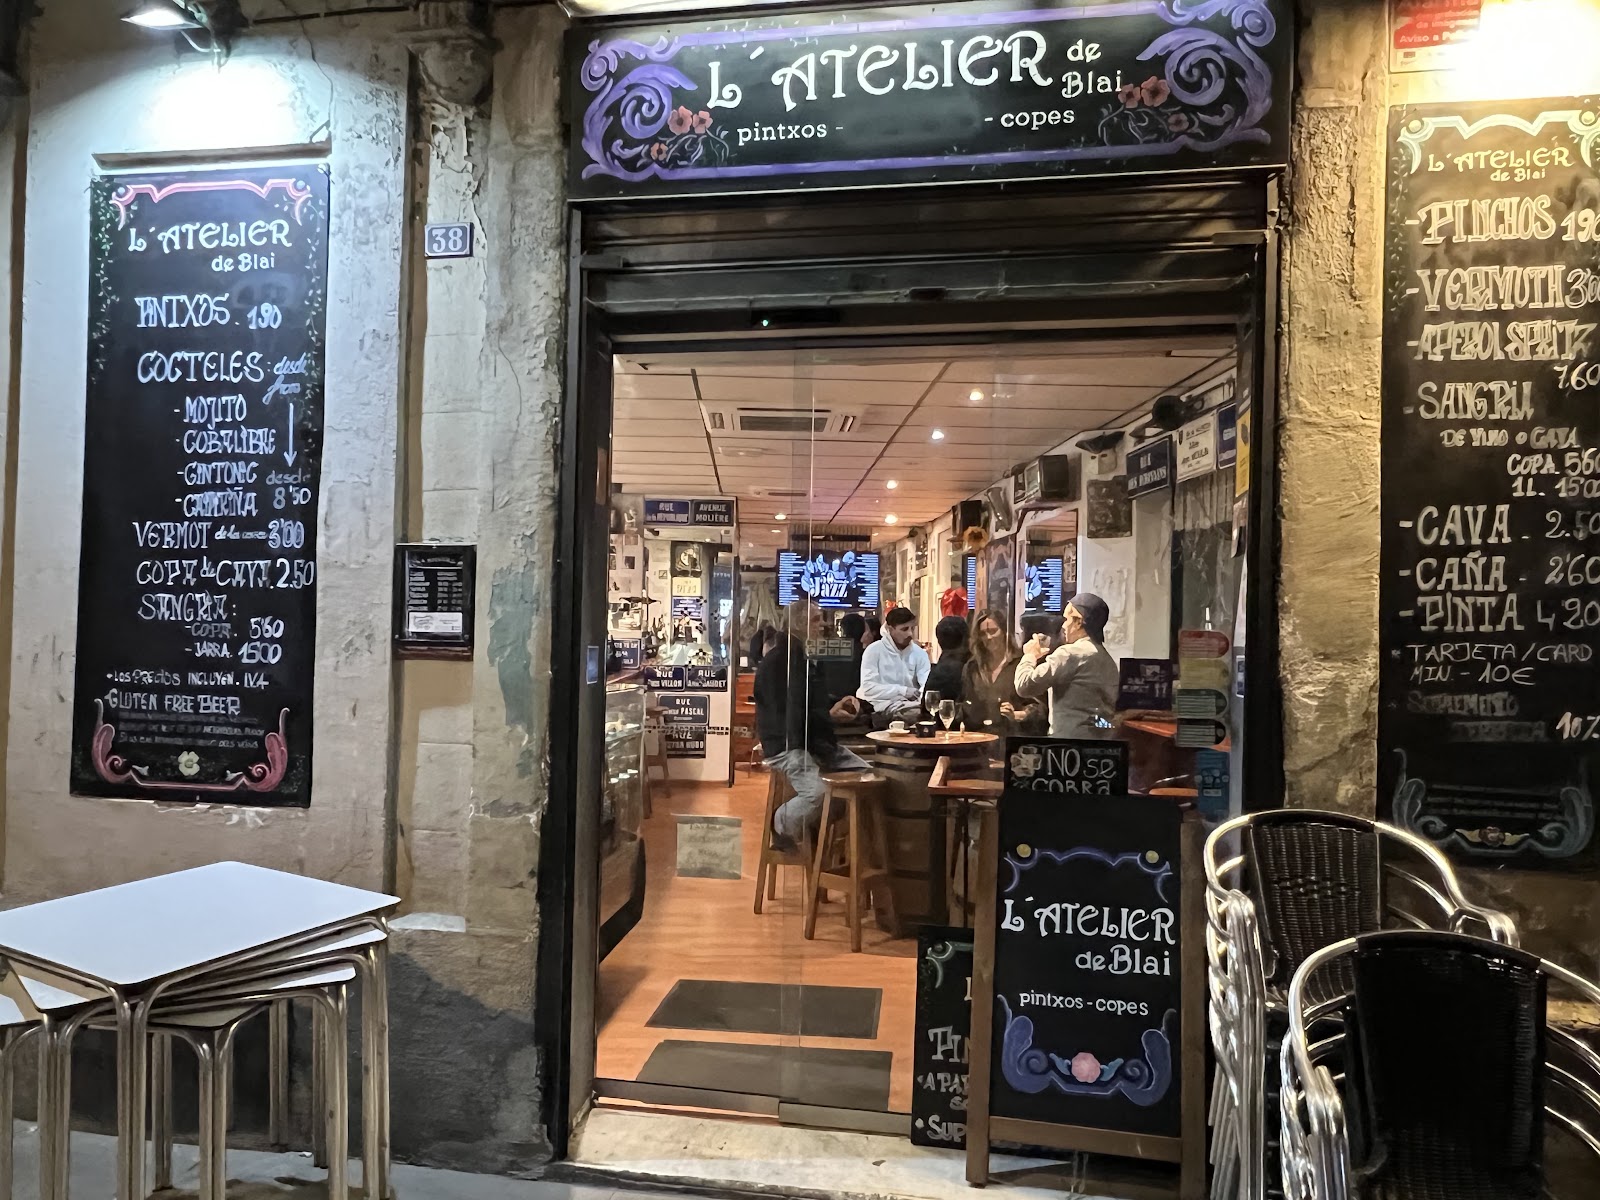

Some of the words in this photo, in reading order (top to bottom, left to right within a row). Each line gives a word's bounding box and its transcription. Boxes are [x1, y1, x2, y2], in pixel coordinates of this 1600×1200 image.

[1067, 39, 1101, 62] de
[1061, 68, 1123, 99] Blai
[737, 121, 828, 145] pintxos
[1000, 106, 1075, 129] copes
[1490, 168, 1511, 182] de
[1514, 167, 1546, 182] Blai
[432, 227, 463, 253] 38
[211, 255, 235, 271] de
[238, 252, 276, 271] Blai
[1439, 428, 1467, 448] DE
[659, 502, 674, 512] RUE
[699, 503, 727, 512] AVENUE
[132, 520, 213, 549] VERMOT
[136, 558, 198, 587] COPA
[809, 576, 848, 598] Jazz
[243, 671, 270, 690] IVA
[1478, 661, 1536, 686] 10€
[164, 694, 195, 714] FREE
[197, 693, 241, 716] BEER
[680, 707, 705, 716] PASCAL
[1047, 748, 1081, 777] NO
[1075, 951, 1106, 971] de
[1108, 944, 1171, 975] Blai
[1019, 989, 1084, 1009] pintxos
[1095, 998, 1149, 1016] copes
